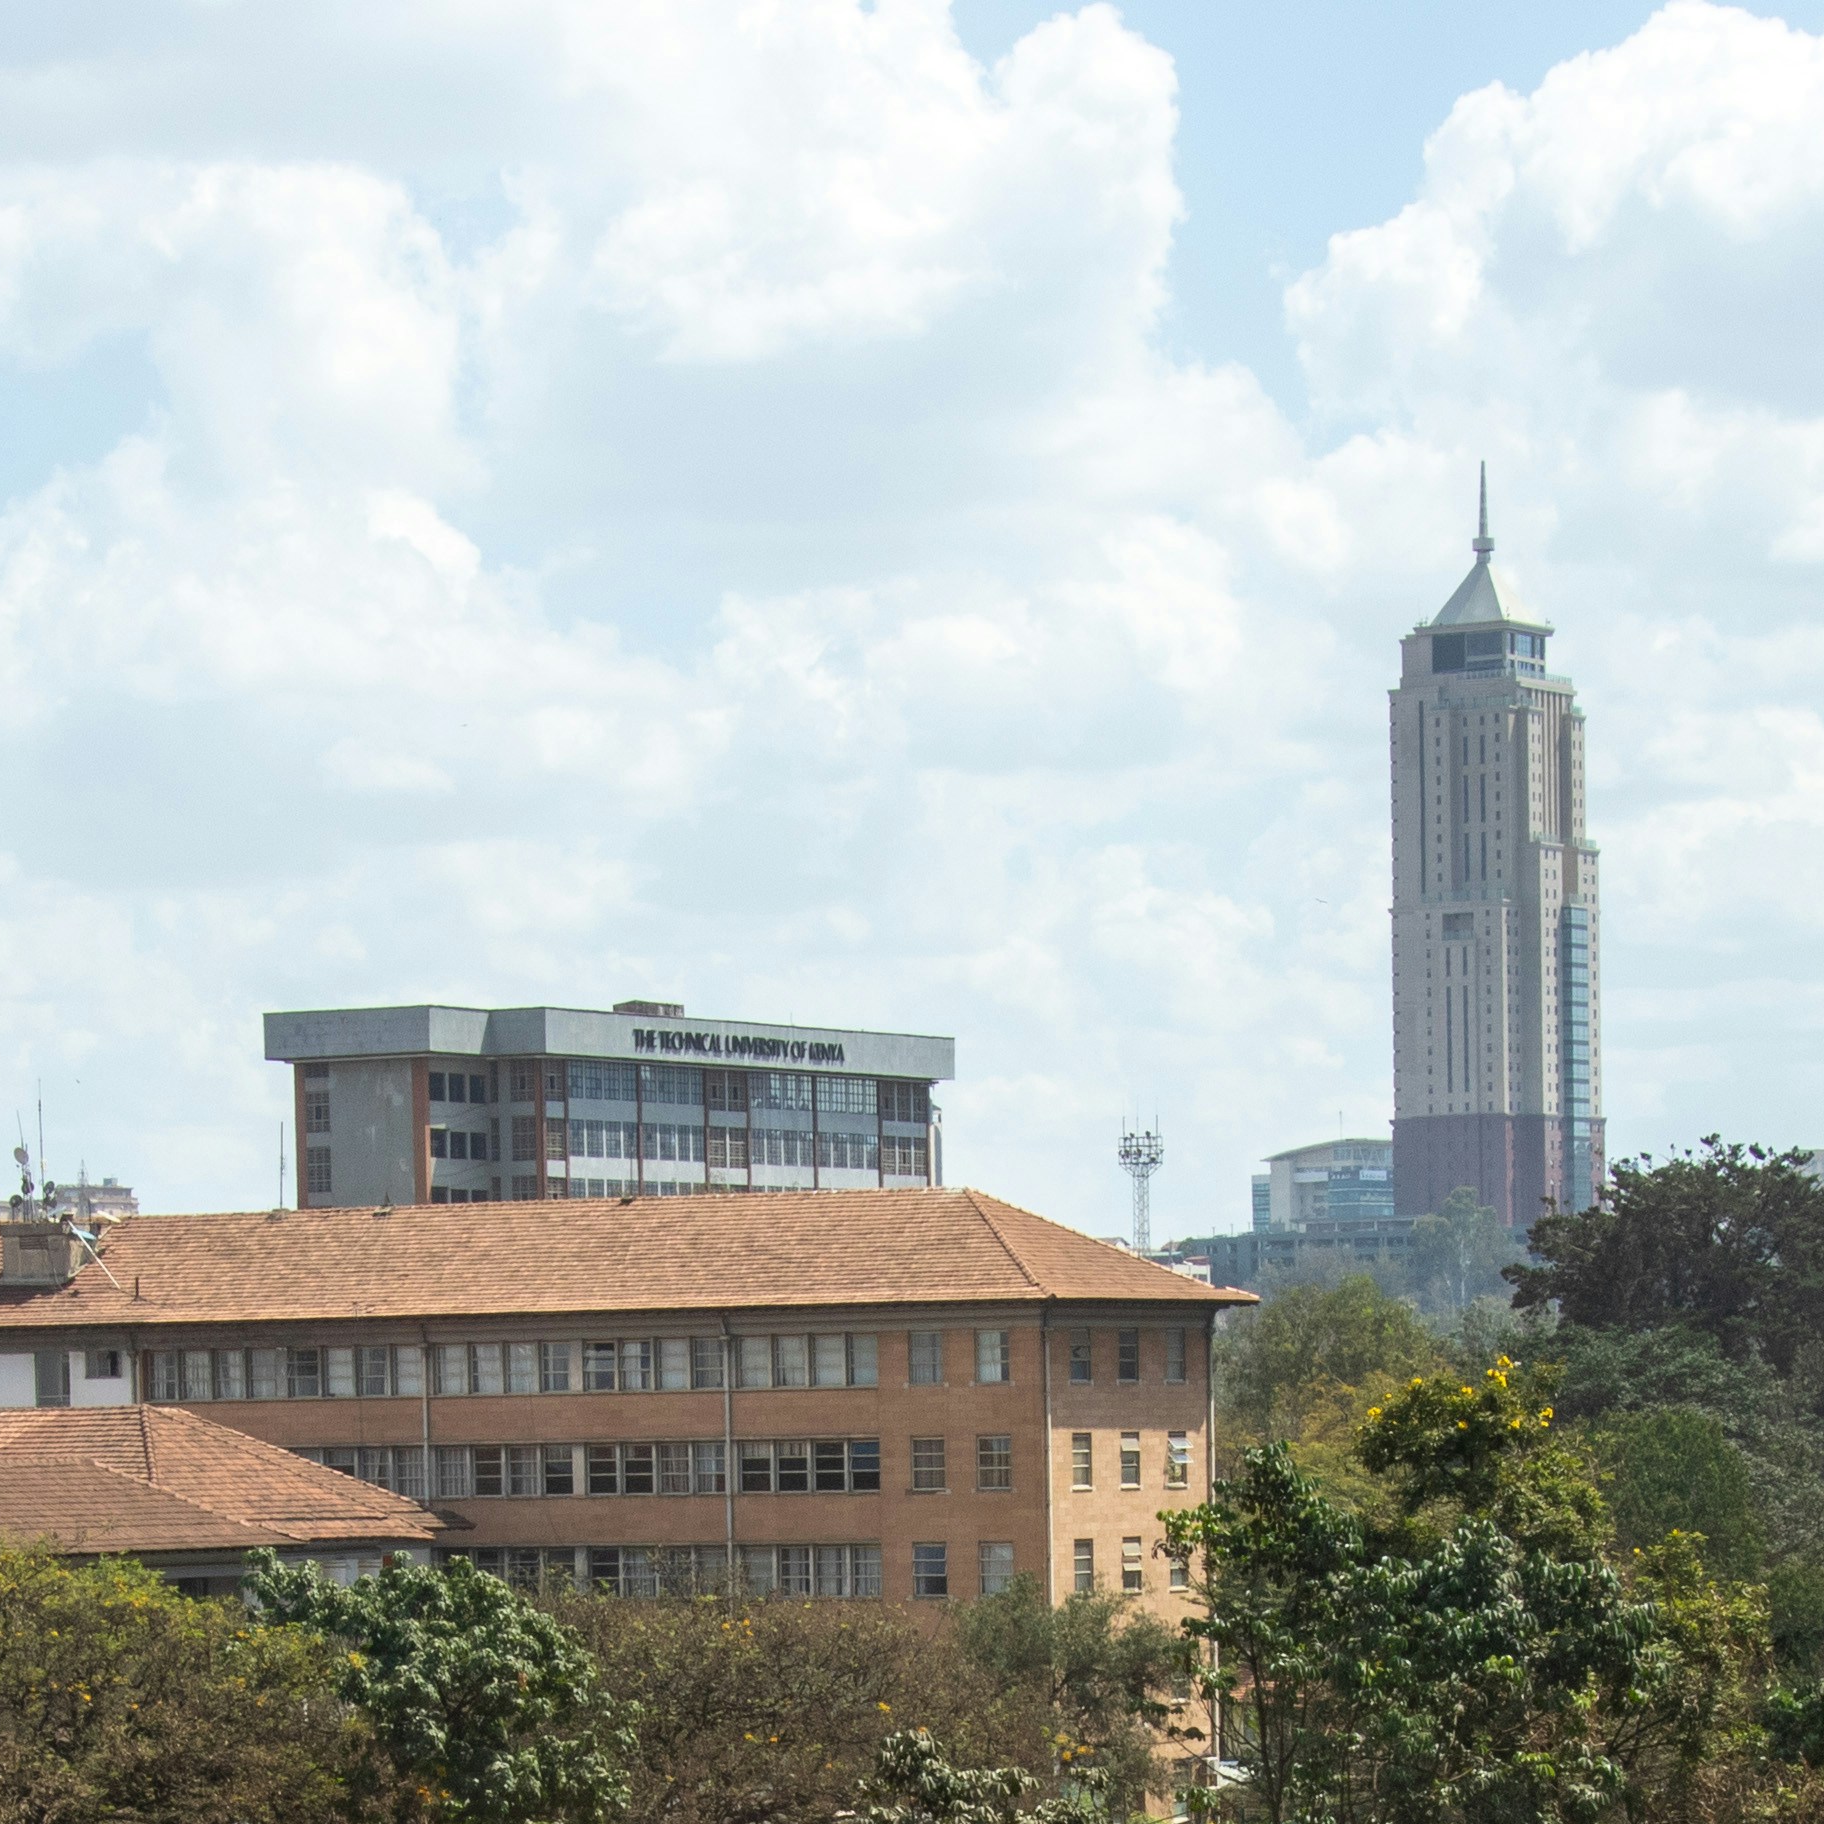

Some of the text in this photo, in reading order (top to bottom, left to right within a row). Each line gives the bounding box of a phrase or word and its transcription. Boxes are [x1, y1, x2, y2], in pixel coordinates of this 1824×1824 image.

[633, 1028, 845, 1062] THE TECHNICAL UNIVERSITY OF KENYA
